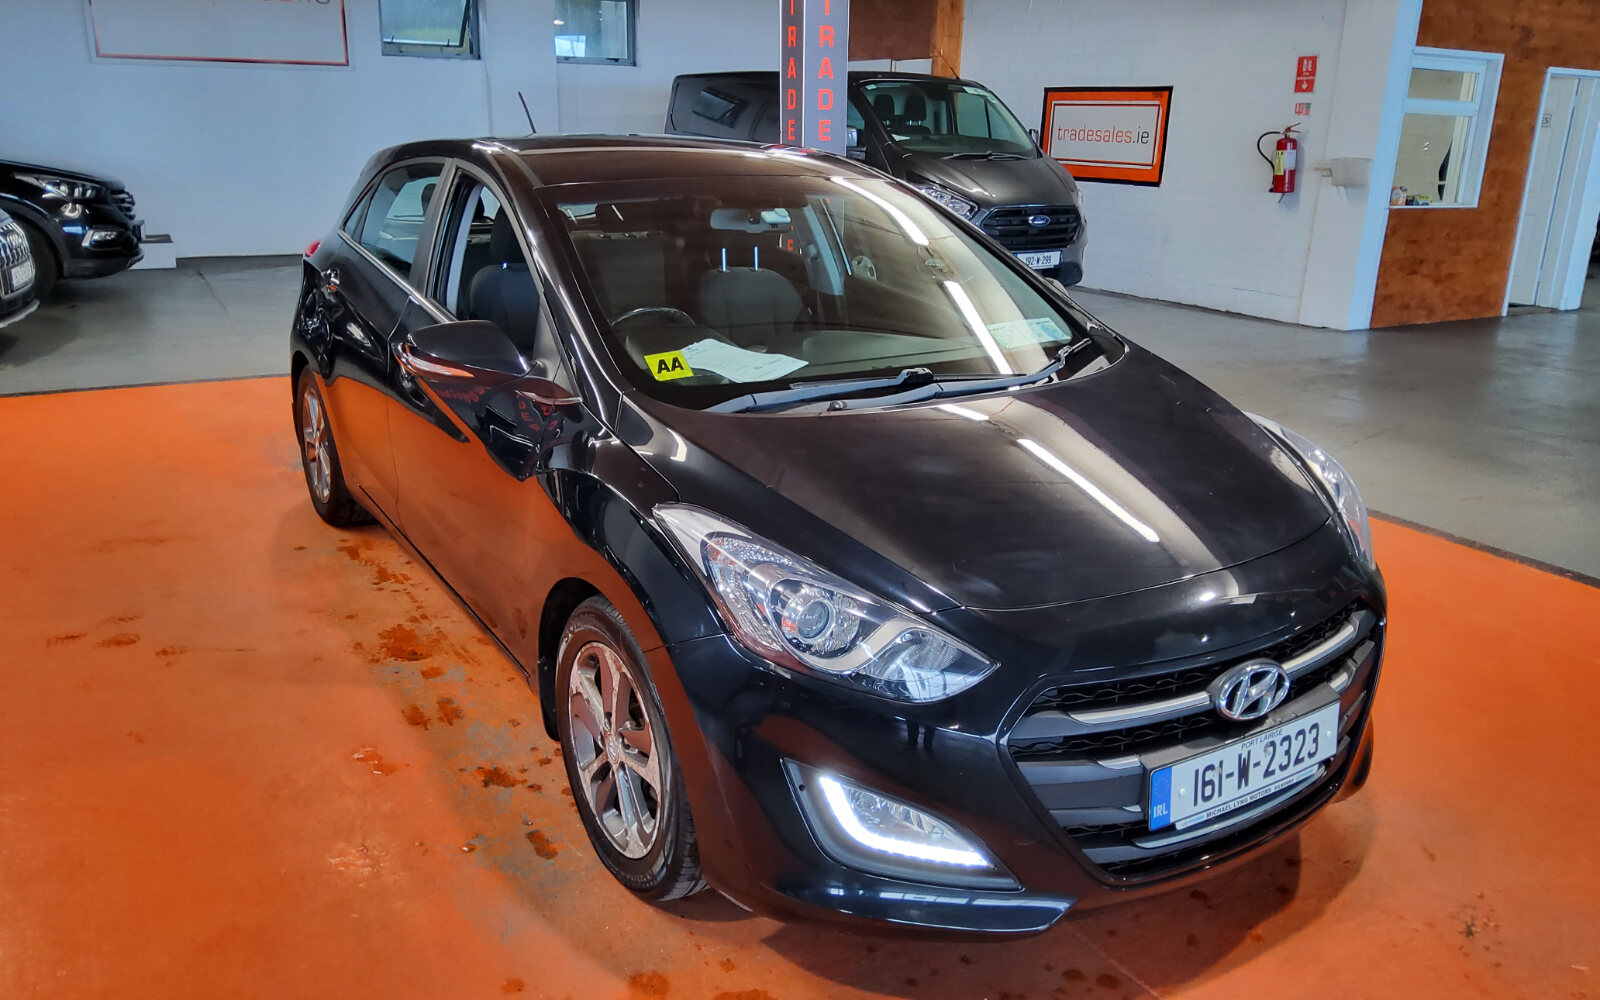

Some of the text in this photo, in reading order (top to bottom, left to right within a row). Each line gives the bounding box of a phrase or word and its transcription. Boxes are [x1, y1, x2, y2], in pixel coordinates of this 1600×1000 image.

[1056, 124, 1150, 144] tradesales.ie
[1025, 255, 1052, 266] 192-W-299
[657, 356, 684, 374] AA
[1241, 737, 1259, 750] PORT
[1193, 721, 1321, 807] 161-W-2323
[1153, 802, 1169, 818] IRL
[1206, 804, 1232, 818] MICHAEL
[1250, 787, 1272, 800] MOTORS
